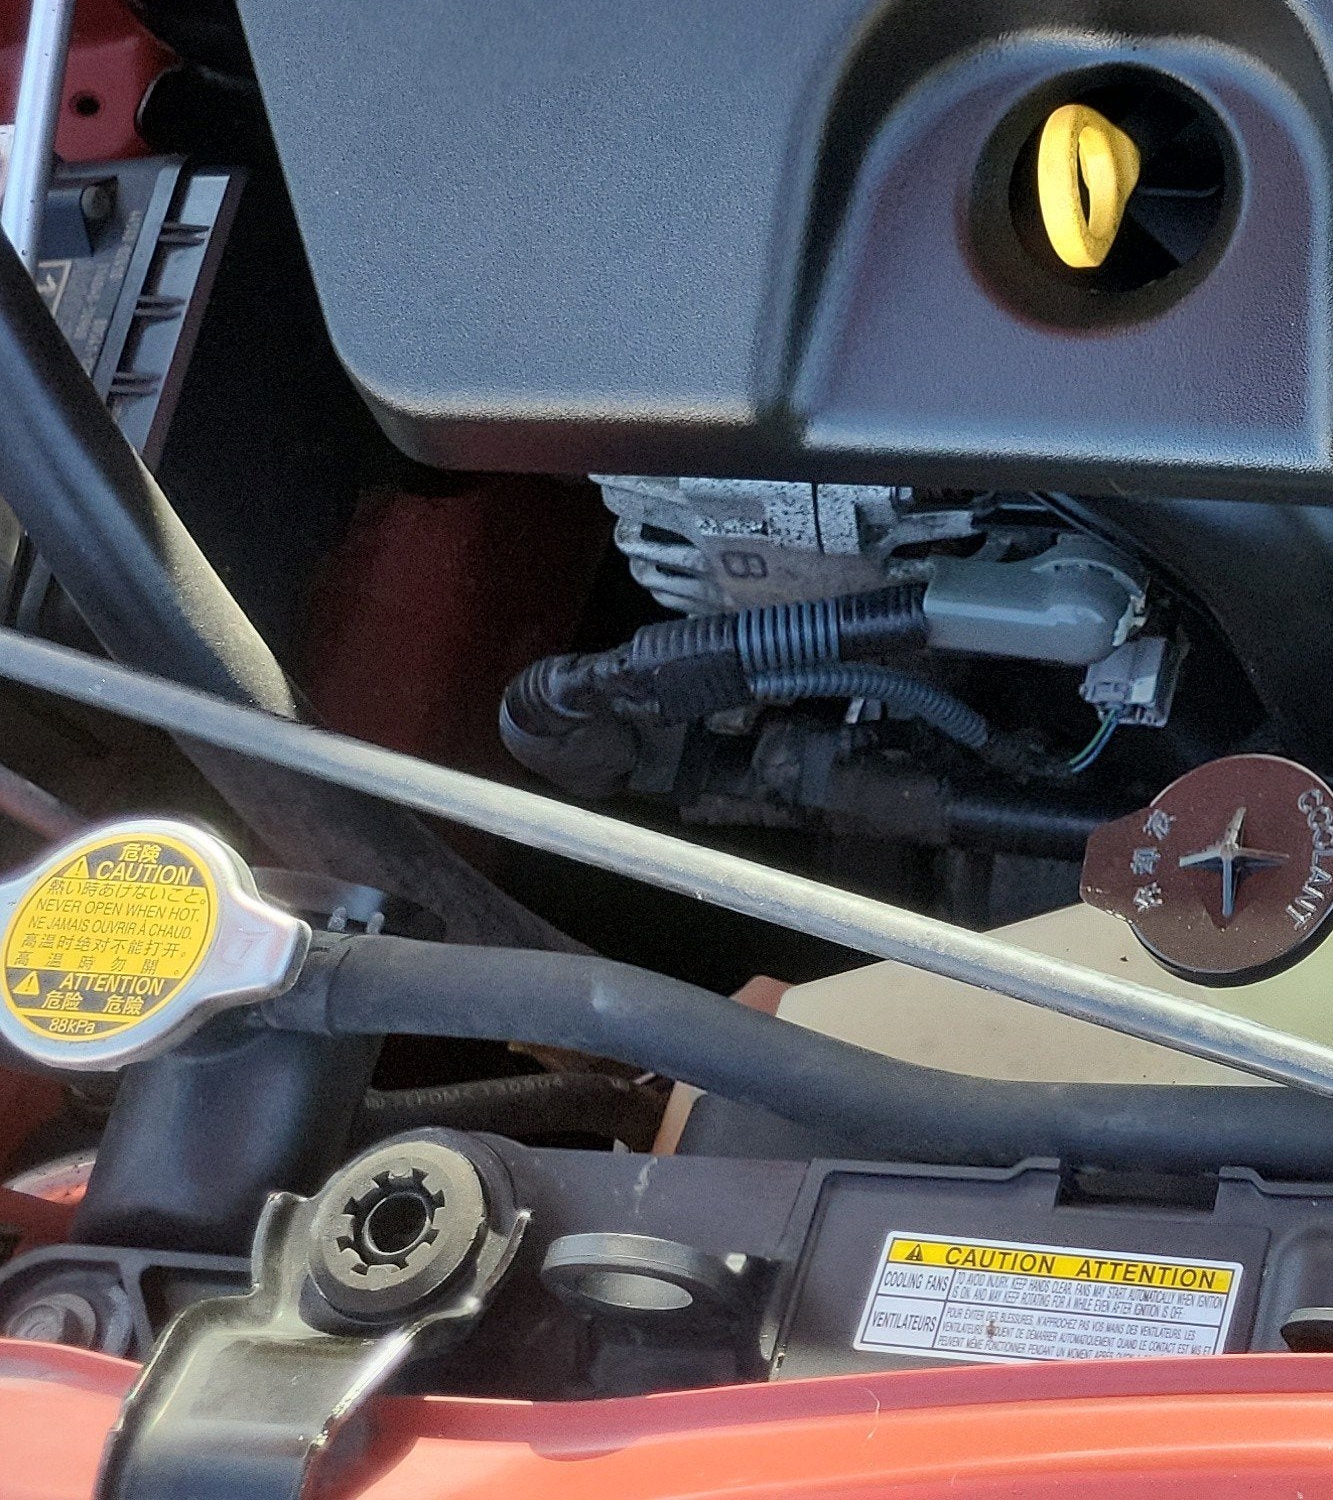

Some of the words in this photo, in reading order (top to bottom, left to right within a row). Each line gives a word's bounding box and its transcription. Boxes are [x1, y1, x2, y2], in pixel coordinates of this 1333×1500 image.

[95, 860, 194, 886] CAUTION
[36, 898, 80, 914] NEVER
[84, 900, 126, 917] OPEN
[126, 903, 167, 919] WHEN
[169, 906, 200, 923] HOT.
[29, 915, 47, 929] NE
[46, 916, 90, 932] JAMAIS
[92, 919, 137, 935] OUVRIR
[149, 923, 192, 940] CHAUD.
[59, 973, 165, 997] ATTENTION
[48, 1017, 96, 1035] 88kPa
[945, 1246, 1057, 1275] CAUTION
[1074, 1258, 1217, 1290] ATTENTION
[884, 1271, 924, 1290] COOLING
[924, 1274, 950, 1293] FANS
[966, 1273, 986, 1287] AVOID
[1011, 1276, 1029, 1290] KEEP
[1029, 1279, 1050, 1294] HANDS
[1074, 1283, 1092, 1297] FANS
[1092, 1284, 1107, 1298] MAY
[1107, 1286, 1127, 1300] START
[1128, 1288, 1175, 1304] AUTOMATICALLY
[1176, 1293, 1196, 1306] WHEN
[1196, 1294, 1223, 1309] IGNITION
[946, 1306, 964, 1318] POUR
[973, 1288, 987, 1300] AND
[1003, 1290, 1021, 1303] KEEP
[1021, 1292, 1050, 1307] ROTATING
[1051, 1295, 1066, 1308] FOR
[1073, 1298, 1092, 1311] WHILE
[1093, 1299, 1109, 1312] EVEN
[1111, 1301, 1132, 1315] AFTER
[1133, 1303, 1159, 1317] IGNITION
[872, 1310, 938, 1333] VENTILATEURS
